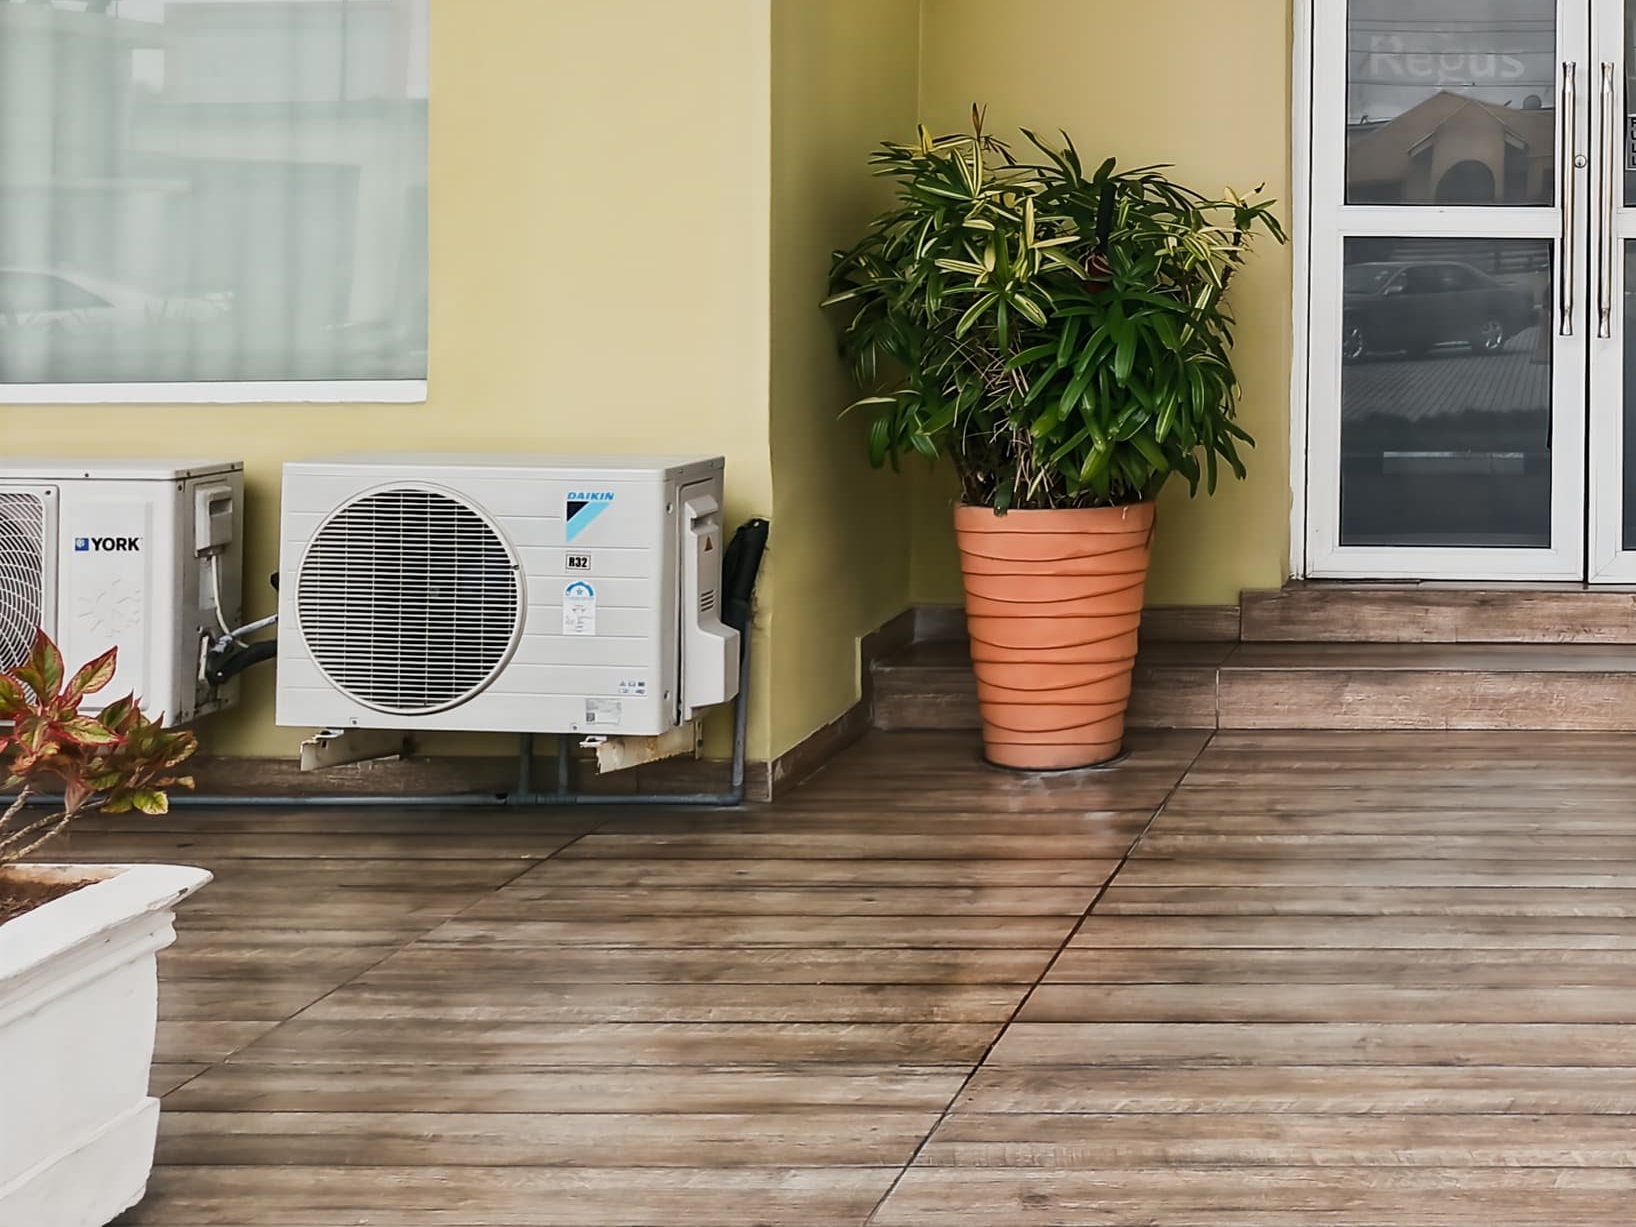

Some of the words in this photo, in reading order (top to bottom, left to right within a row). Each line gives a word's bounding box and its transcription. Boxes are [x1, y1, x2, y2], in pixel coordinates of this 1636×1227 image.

[567, 492, 615, 501] DAIKIN
[91, 537, 140, 552] YORK
[568, 556, 588, 568] R32
